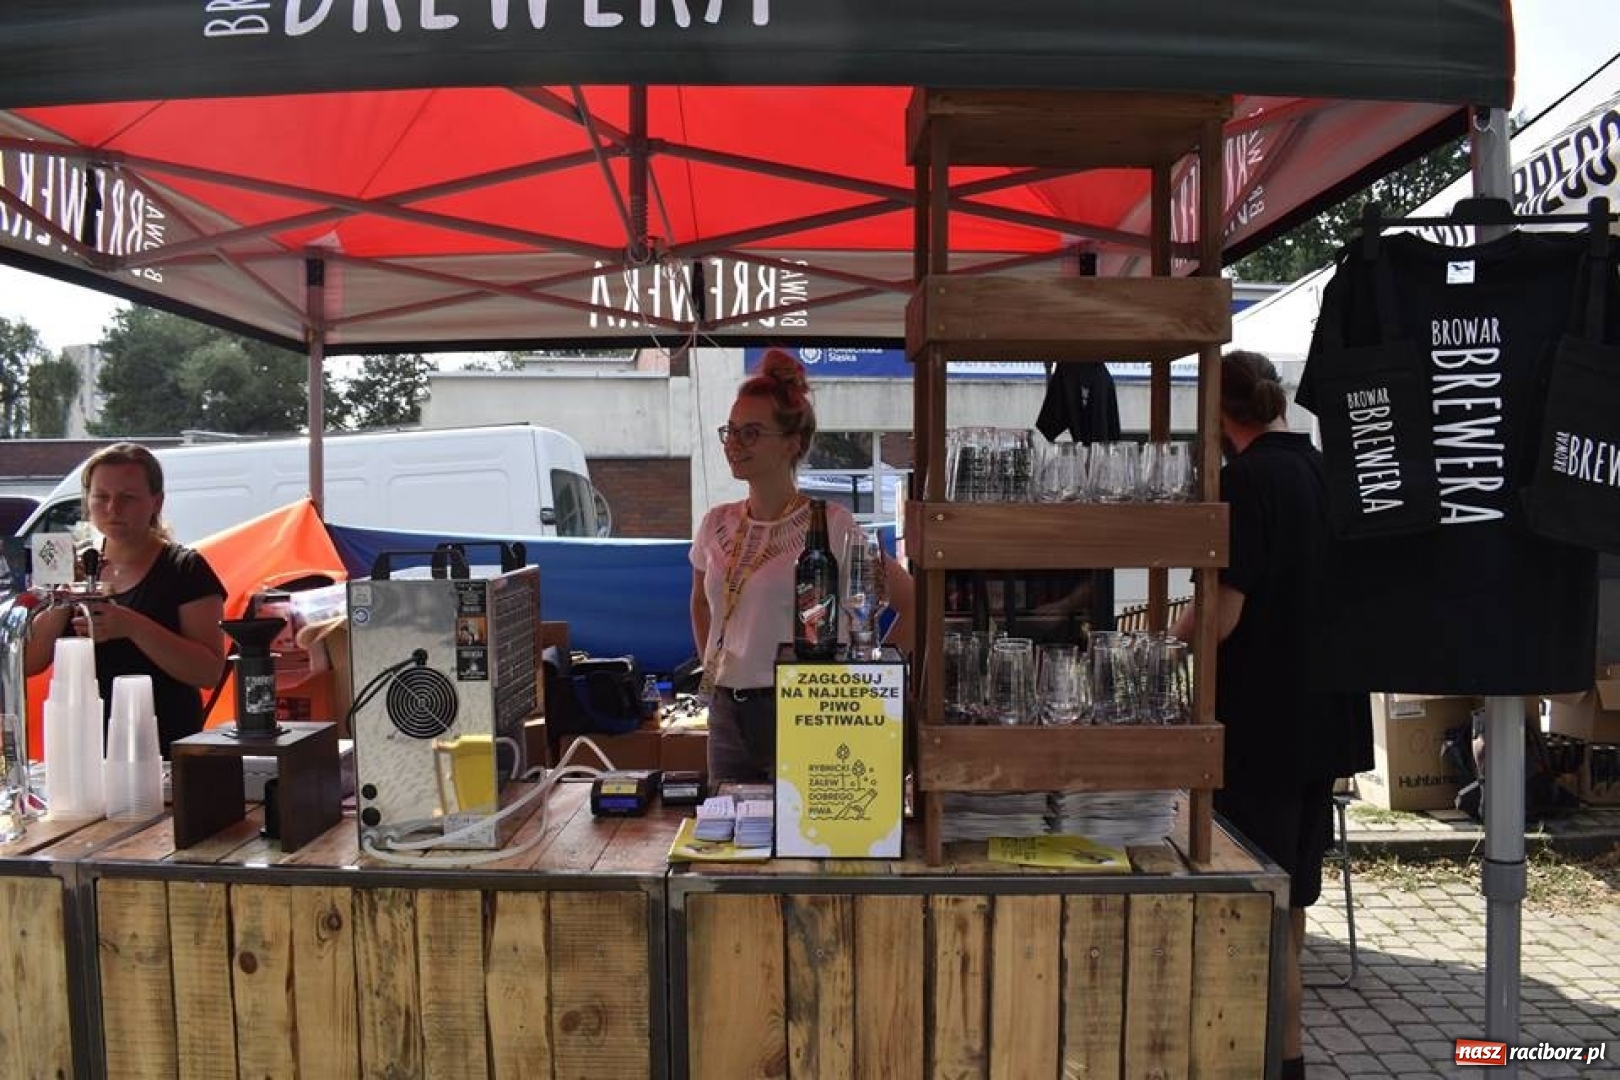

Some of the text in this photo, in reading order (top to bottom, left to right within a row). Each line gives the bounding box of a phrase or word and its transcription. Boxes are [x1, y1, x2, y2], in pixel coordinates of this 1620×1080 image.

[1431, 316, 1501, 346] BROWAR
[1347, 387, 1390, 409] BROWAR
[1431, 347, 1505, 524] BREWERA
[1349, 405, 1405, 513] BREWERA
[797, 673, 882, 684] ZAGŁOSUJ
[780, 687, 899, 698] NA NAJLEPSZE
[819, 701, 860, 712] PIWO
[795, 715, 885, 726] FESTIWALU
[808, 764, 849, 772] RYBNICKI
